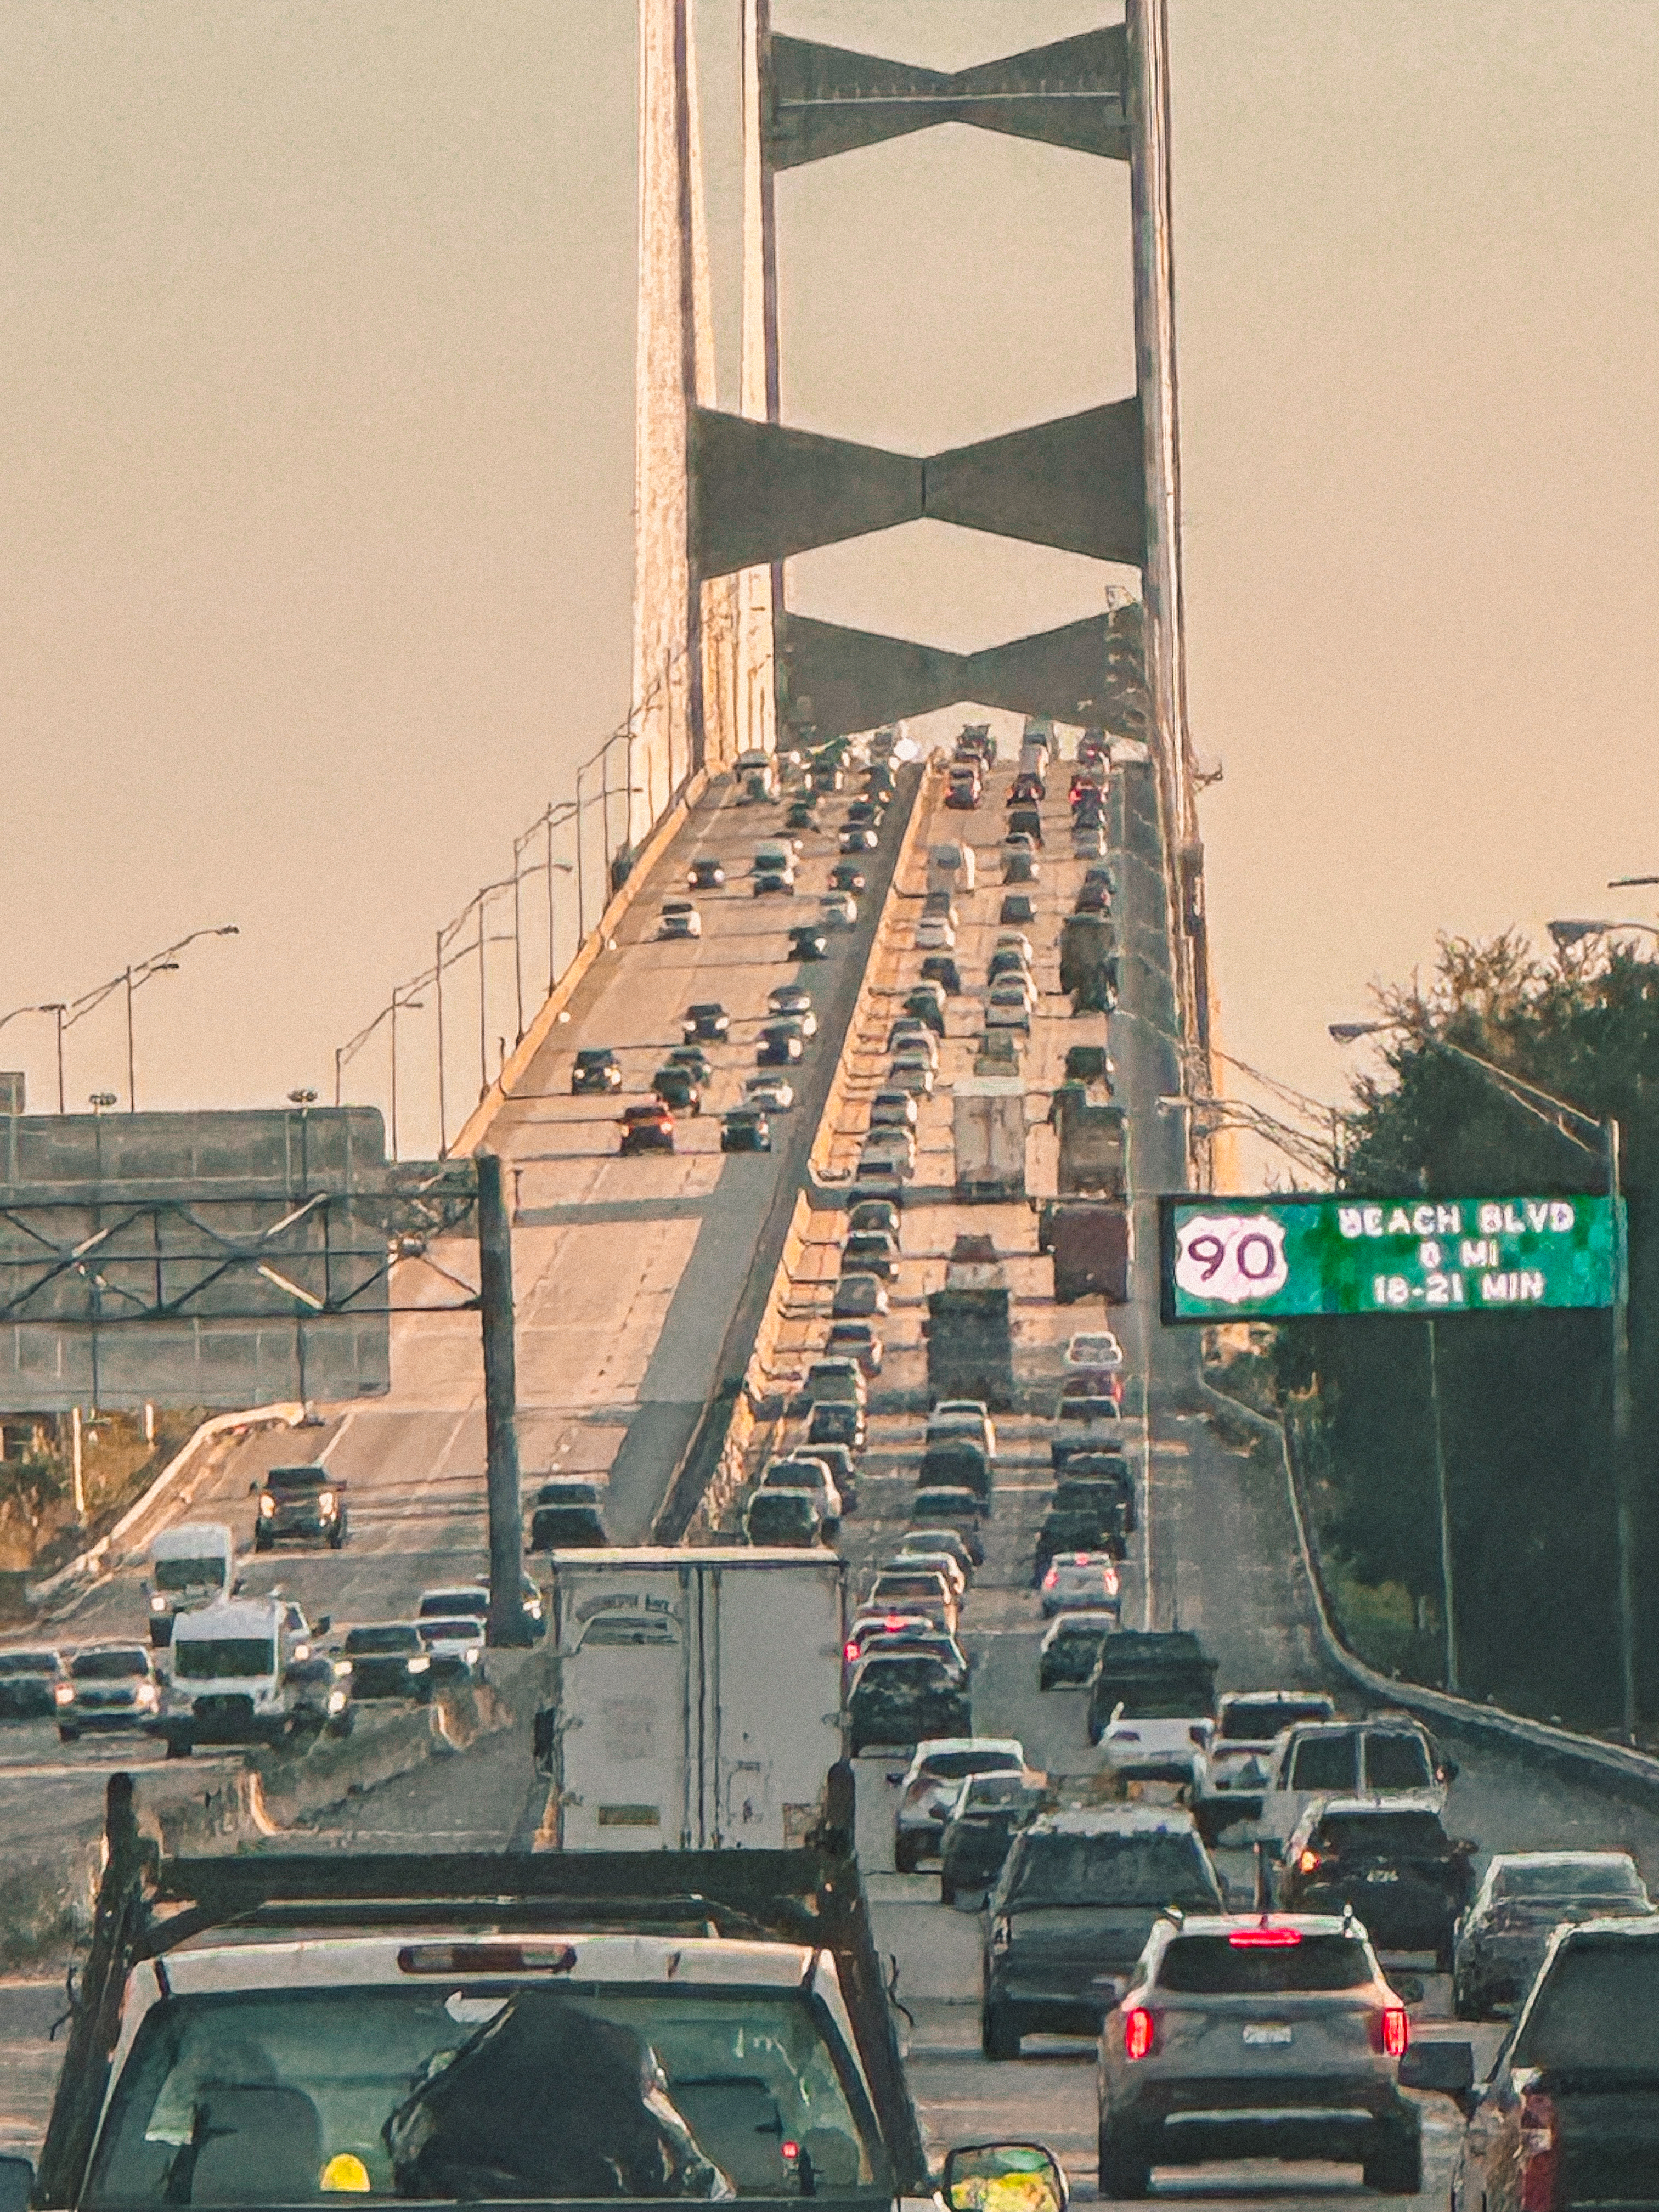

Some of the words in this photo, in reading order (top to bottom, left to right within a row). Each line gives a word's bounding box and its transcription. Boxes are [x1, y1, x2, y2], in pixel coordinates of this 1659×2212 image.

[1339, 1204, 1460, 1238] BEACH
[1480, 1201, 1575, 1234] BLVD
[1188, 1234, 1276, 1282] 90
[1462, 1239, 1499, 1267] MI
[1482, 1271, 1545, 1301] MIN
